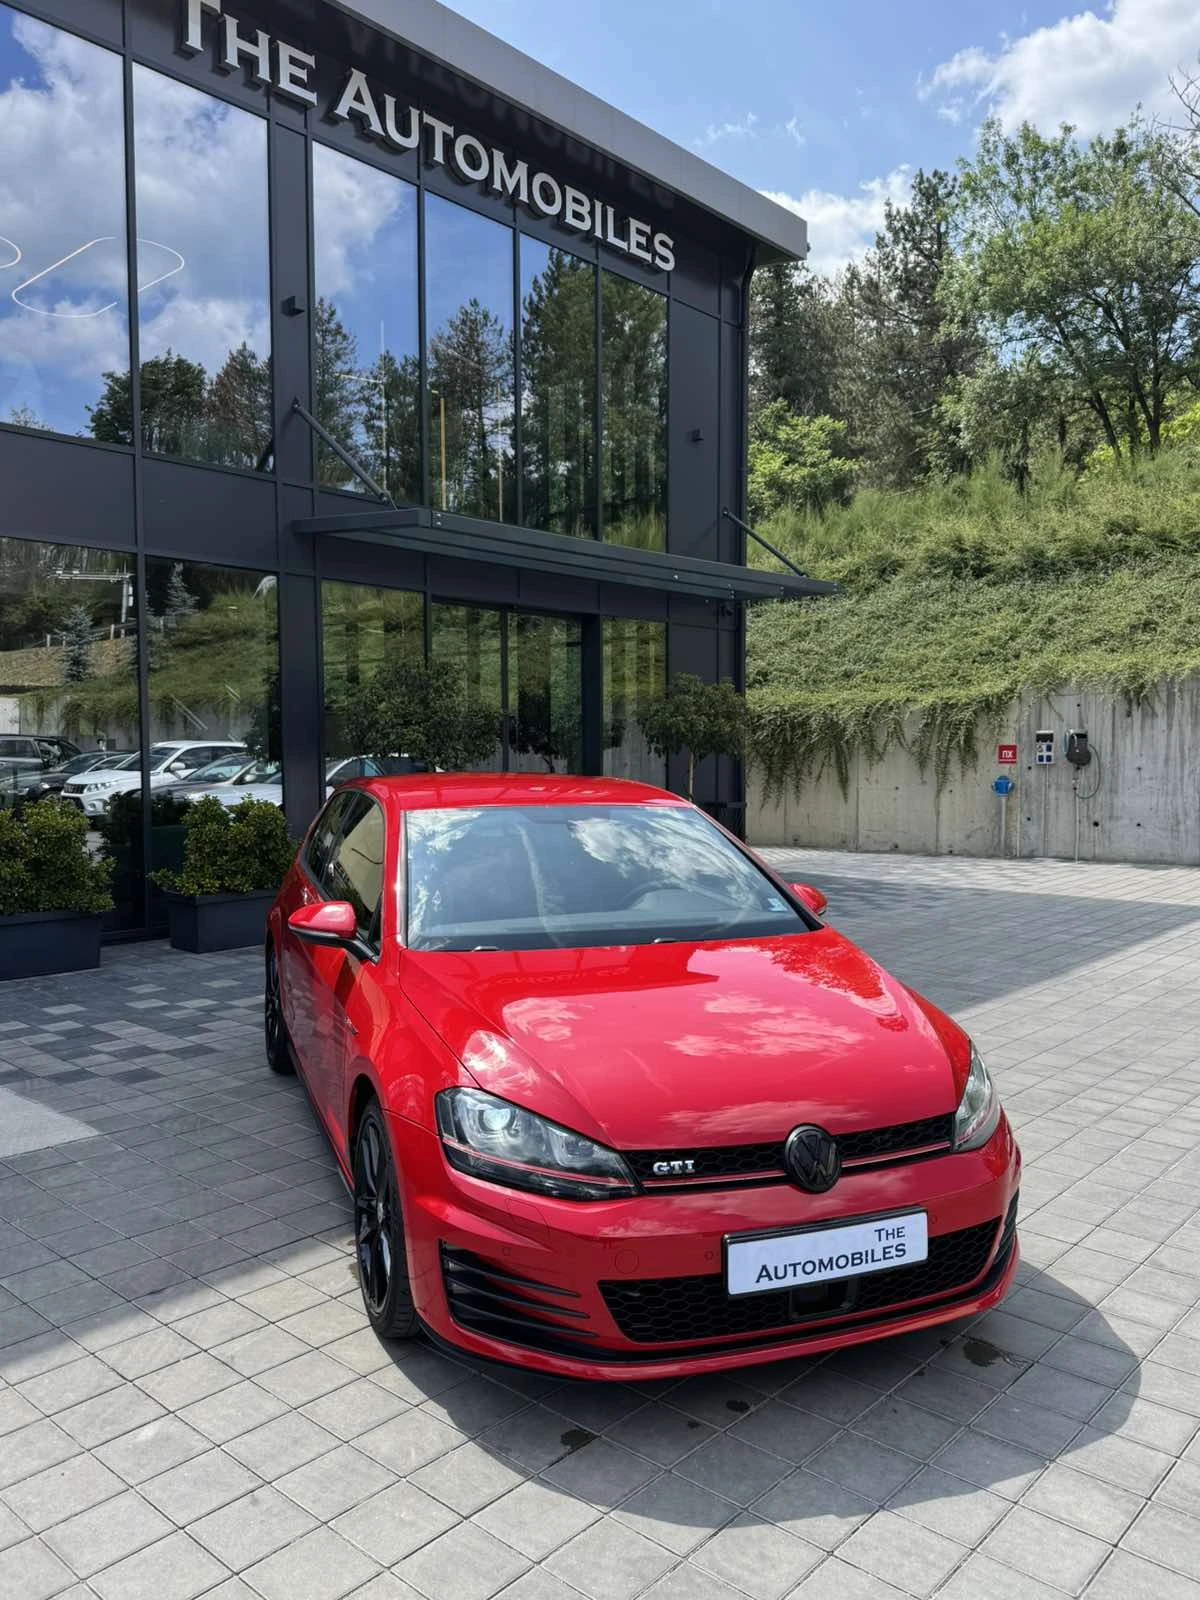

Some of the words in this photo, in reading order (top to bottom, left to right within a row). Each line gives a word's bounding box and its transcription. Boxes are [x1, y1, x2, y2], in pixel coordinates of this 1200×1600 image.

[185, 0, 317, 106] THE
[333, 68, 676, 272] AUTOMOBILES
[652, 1159, 695, 1176] GTI
[874, 1226, 906, 1242] THE
[755, 1243, 907, 1284] AUTOMOBILES
